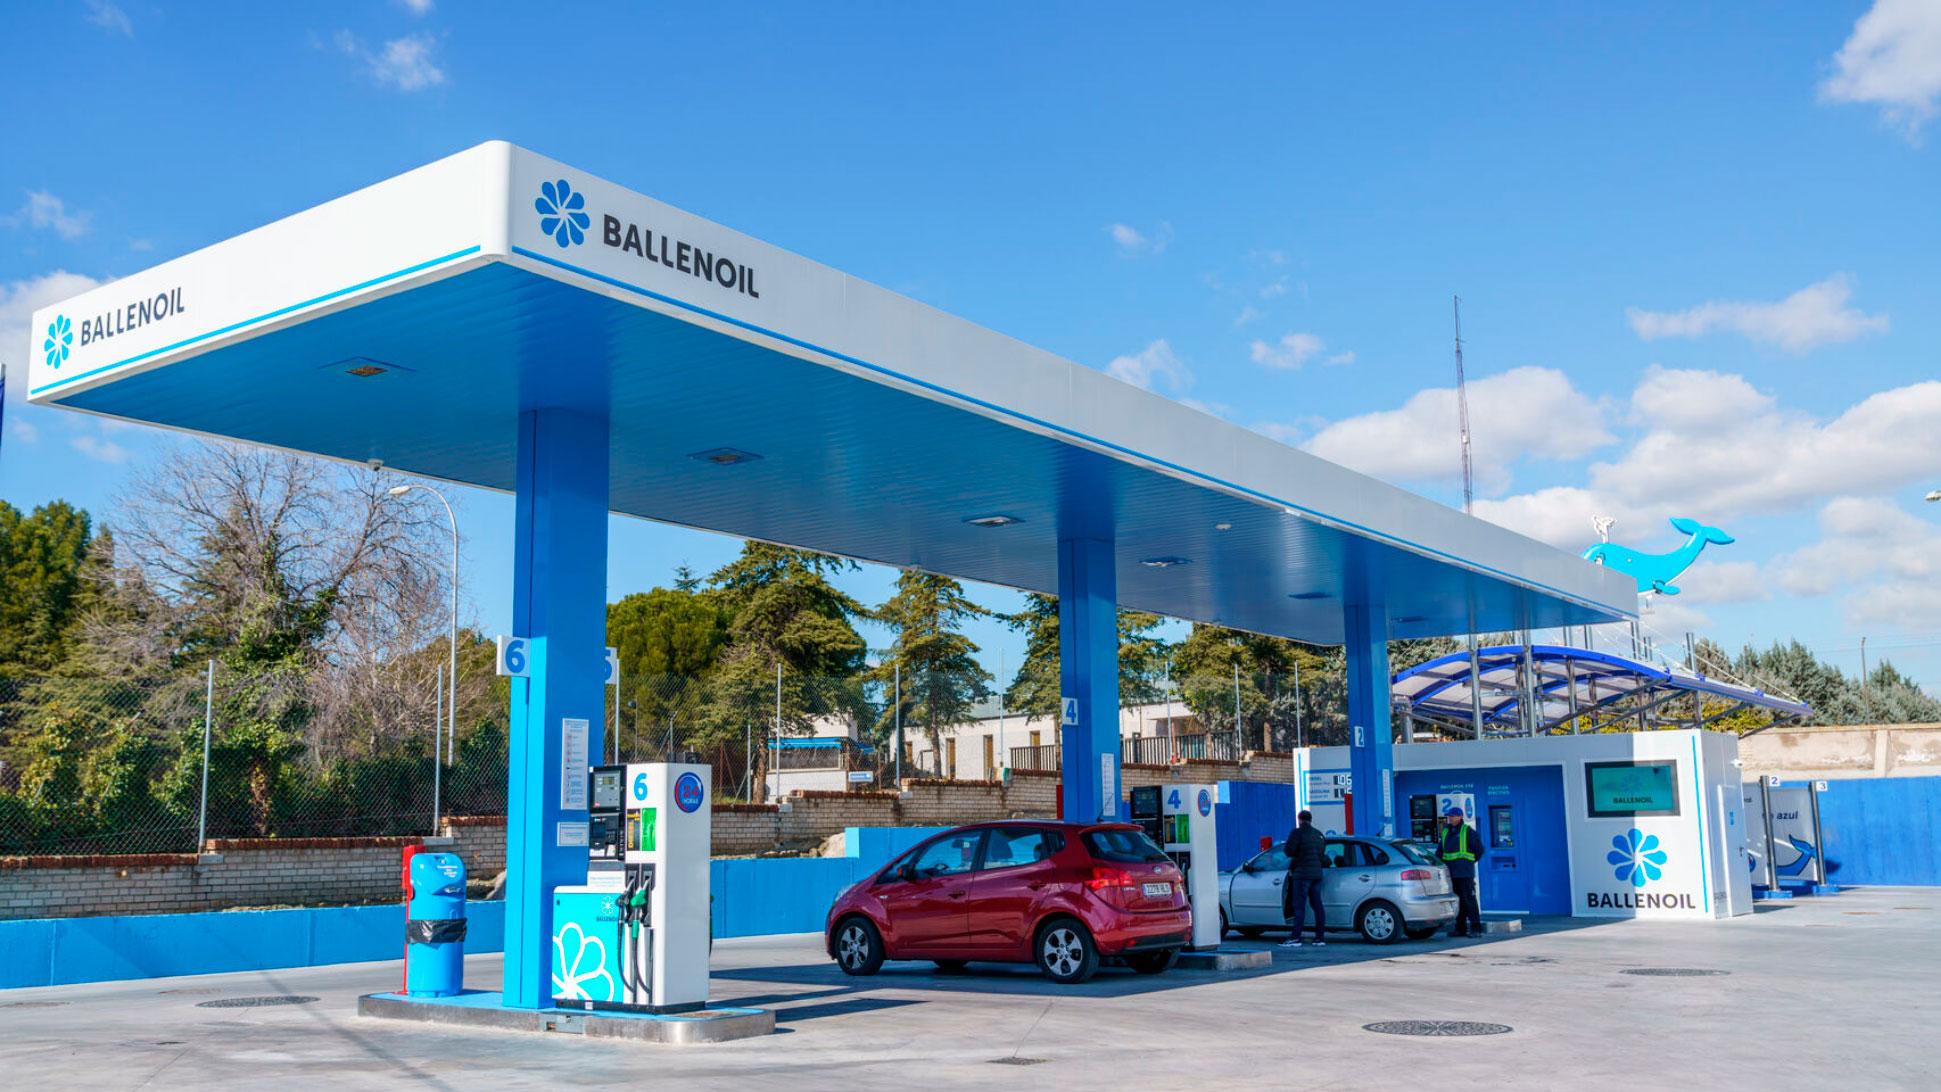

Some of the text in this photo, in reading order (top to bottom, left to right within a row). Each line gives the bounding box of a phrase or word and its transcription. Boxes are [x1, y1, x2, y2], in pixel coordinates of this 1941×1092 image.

[603, 214, 760, 299] BALLENOIL
[80, 286, 185, 347] BALLENOIL
[505, 640, 526, 673] 6
[1065, 700, 1077, 723] 4
[1357, 728, 1365, 745] 2
[633, 772, 648, 801] 6
[1771, 776, 1778, 785] 2
[1819, 782, 1826, 790] 3
[683, 785, 699, 798] 24
[1167, 789, 1182, 809] 4
[1613, 796, 1653, 804] BALLENOIL
[1442, 798, 1452, 813] 2
[1776, 810, 1799, 820] azul
[1587, 892, 1696, 910] BALLENOIL
